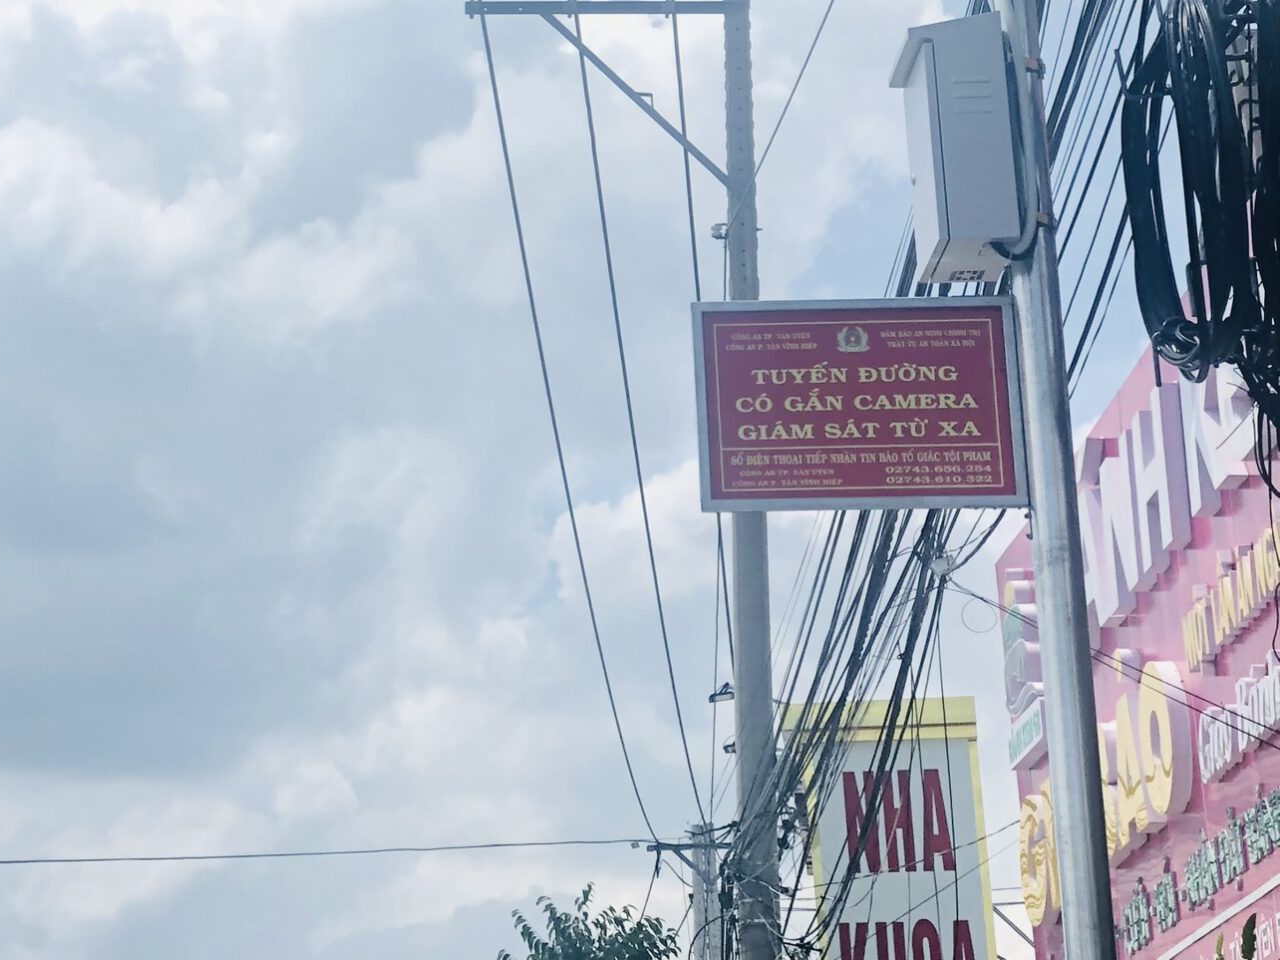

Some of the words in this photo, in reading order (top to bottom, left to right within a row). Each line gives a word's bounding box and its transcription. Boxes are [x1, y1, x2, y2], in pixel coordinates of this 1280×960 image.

[751, 361, 848, 385] TUYẾN
[858, 362, 959, 383] ĐƯỜNG
[735, 393, 773, 413] CÓ
[784, 388, 844, 412] GẮN
[853, 393, 979, 411] CAMERA
[737, 420, 815, 441] GIÁM
[824, 419, 880, 439] SÁT
[890, 418, 929, 438] TỪ
[938, 421, 982, 437] XA
[731, 451, 744, 466] SỐ
[917, 449, 941, 462] GIÁC
[842, 769, 956, 873] NHA
